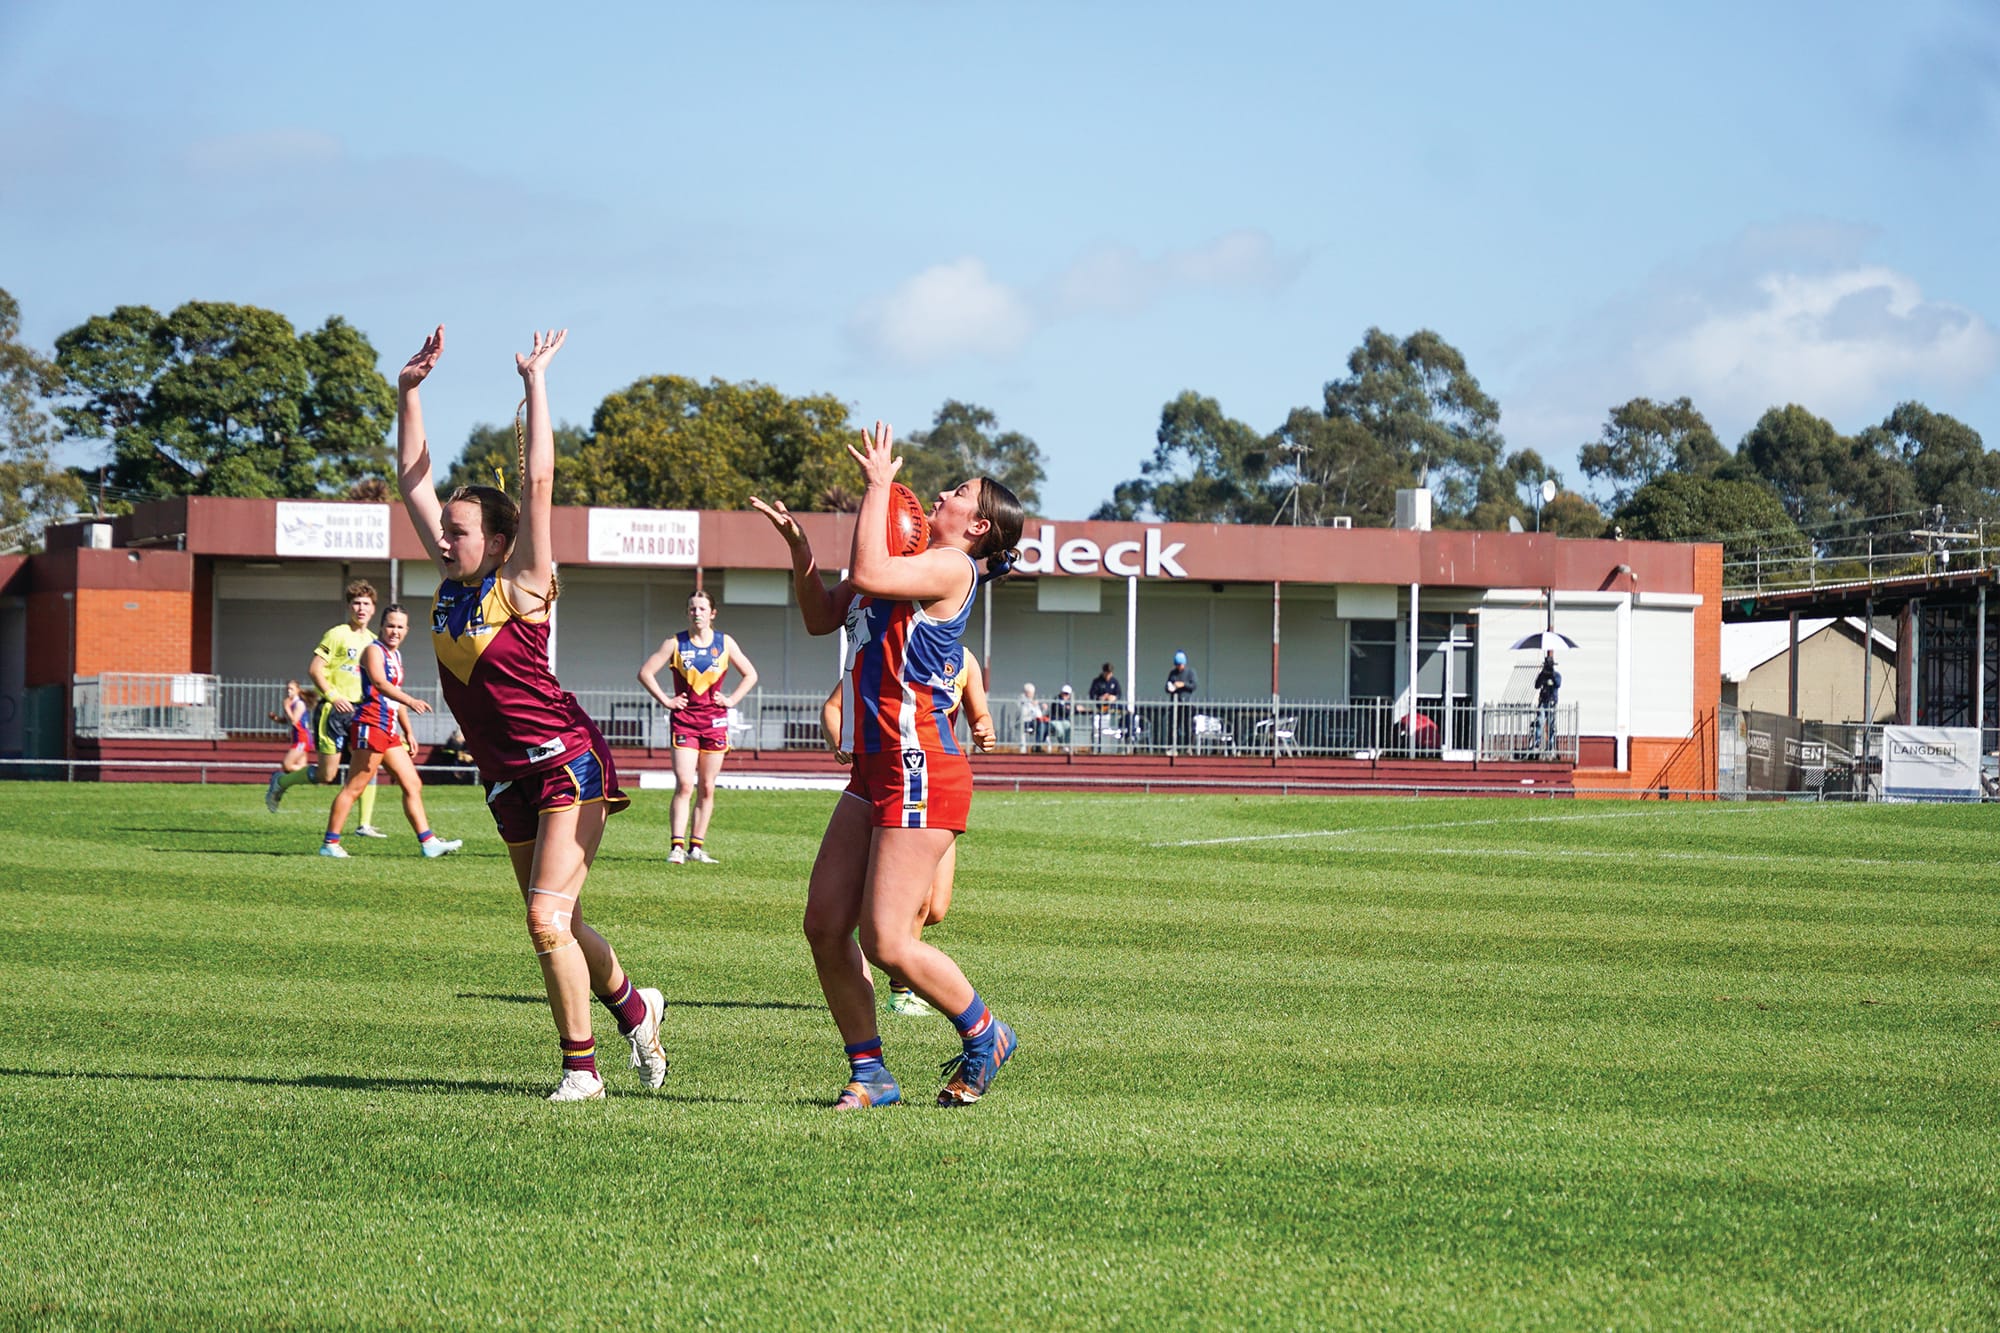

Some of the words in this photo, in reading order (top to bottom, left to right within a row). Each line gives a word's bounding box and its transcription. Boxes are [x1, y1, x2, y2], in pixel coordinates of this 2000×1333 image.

[326, 514, 350, 527] Home
[354, 514, 363, 527] of
[367, 514, 383, 528] The
[631, 521, 654, 533] Home
[658, 522, 667, 533] of
[671, 522, 686, 534] The
[324, 530, 385, 549] SHARKS
[622, 536, 695, 556] MAROONS
[1011, 524, 1189, 577] deck
[1893, 745, 1952, 757] LANGDEN
